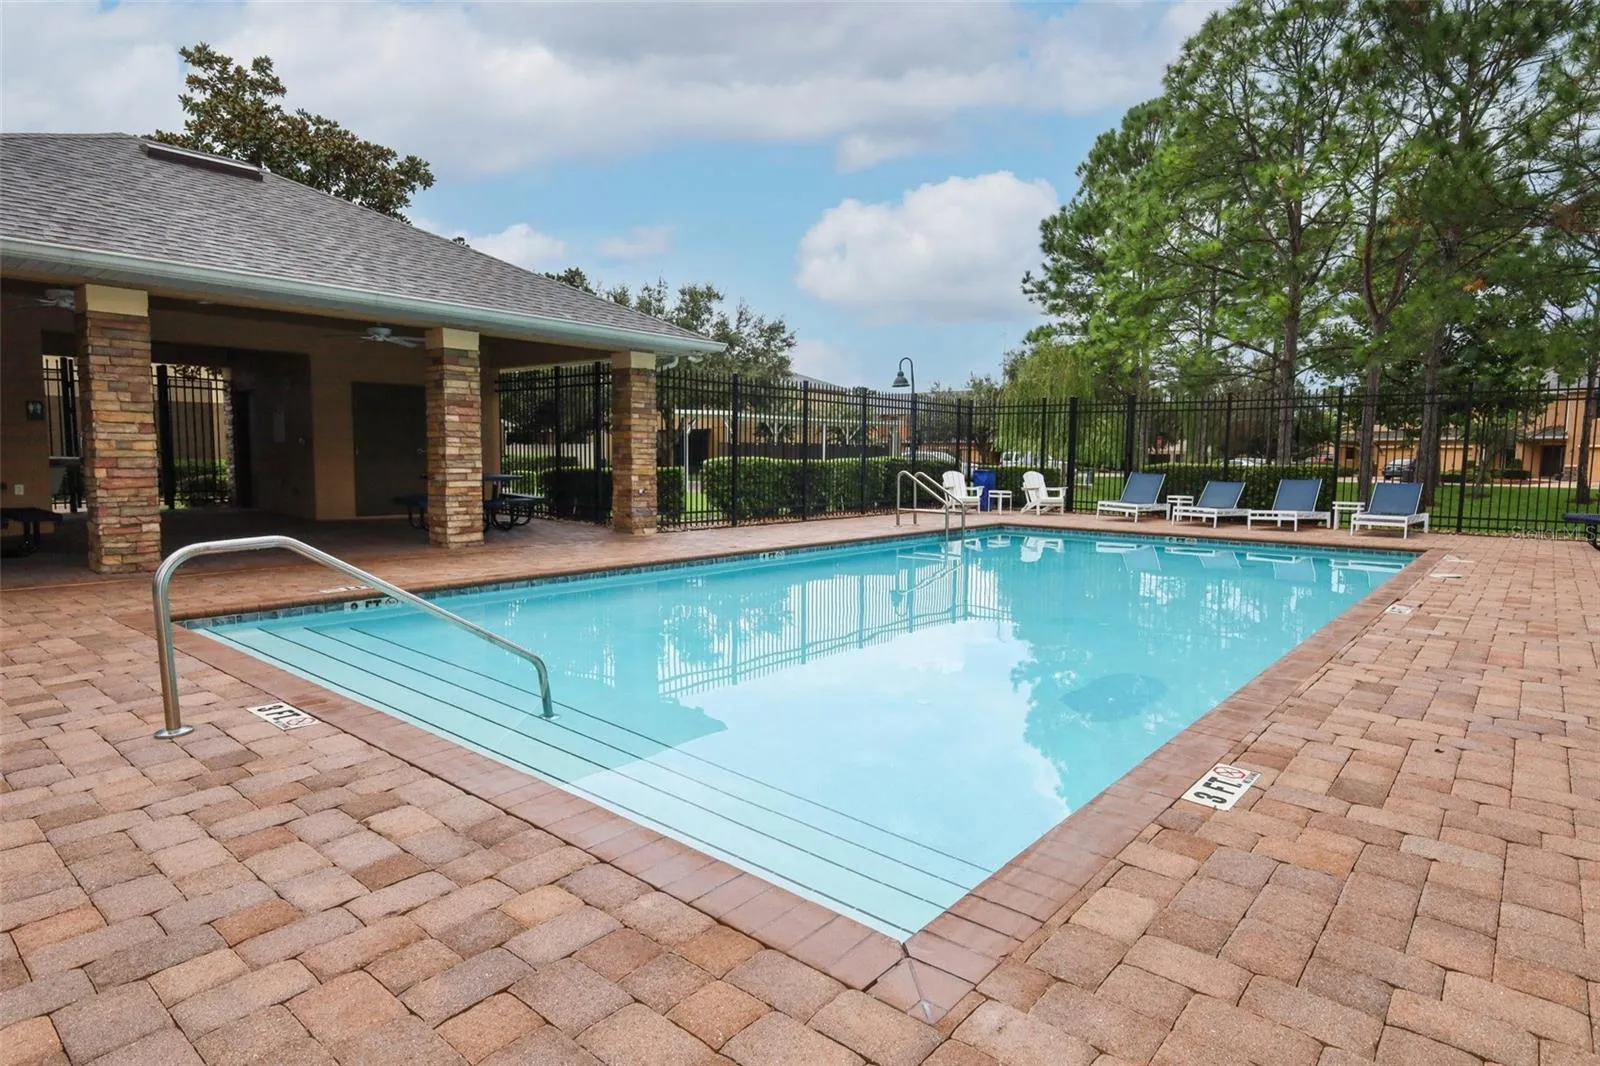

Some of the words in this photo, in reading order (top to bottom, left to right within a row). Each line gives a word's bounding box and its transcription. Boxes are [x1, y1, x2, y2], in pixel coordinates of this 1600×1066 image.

[265, 709, 302, 721] FT
[1202, 776, 1243, 796] FT
[1193, 791, 1227, 804] 3
